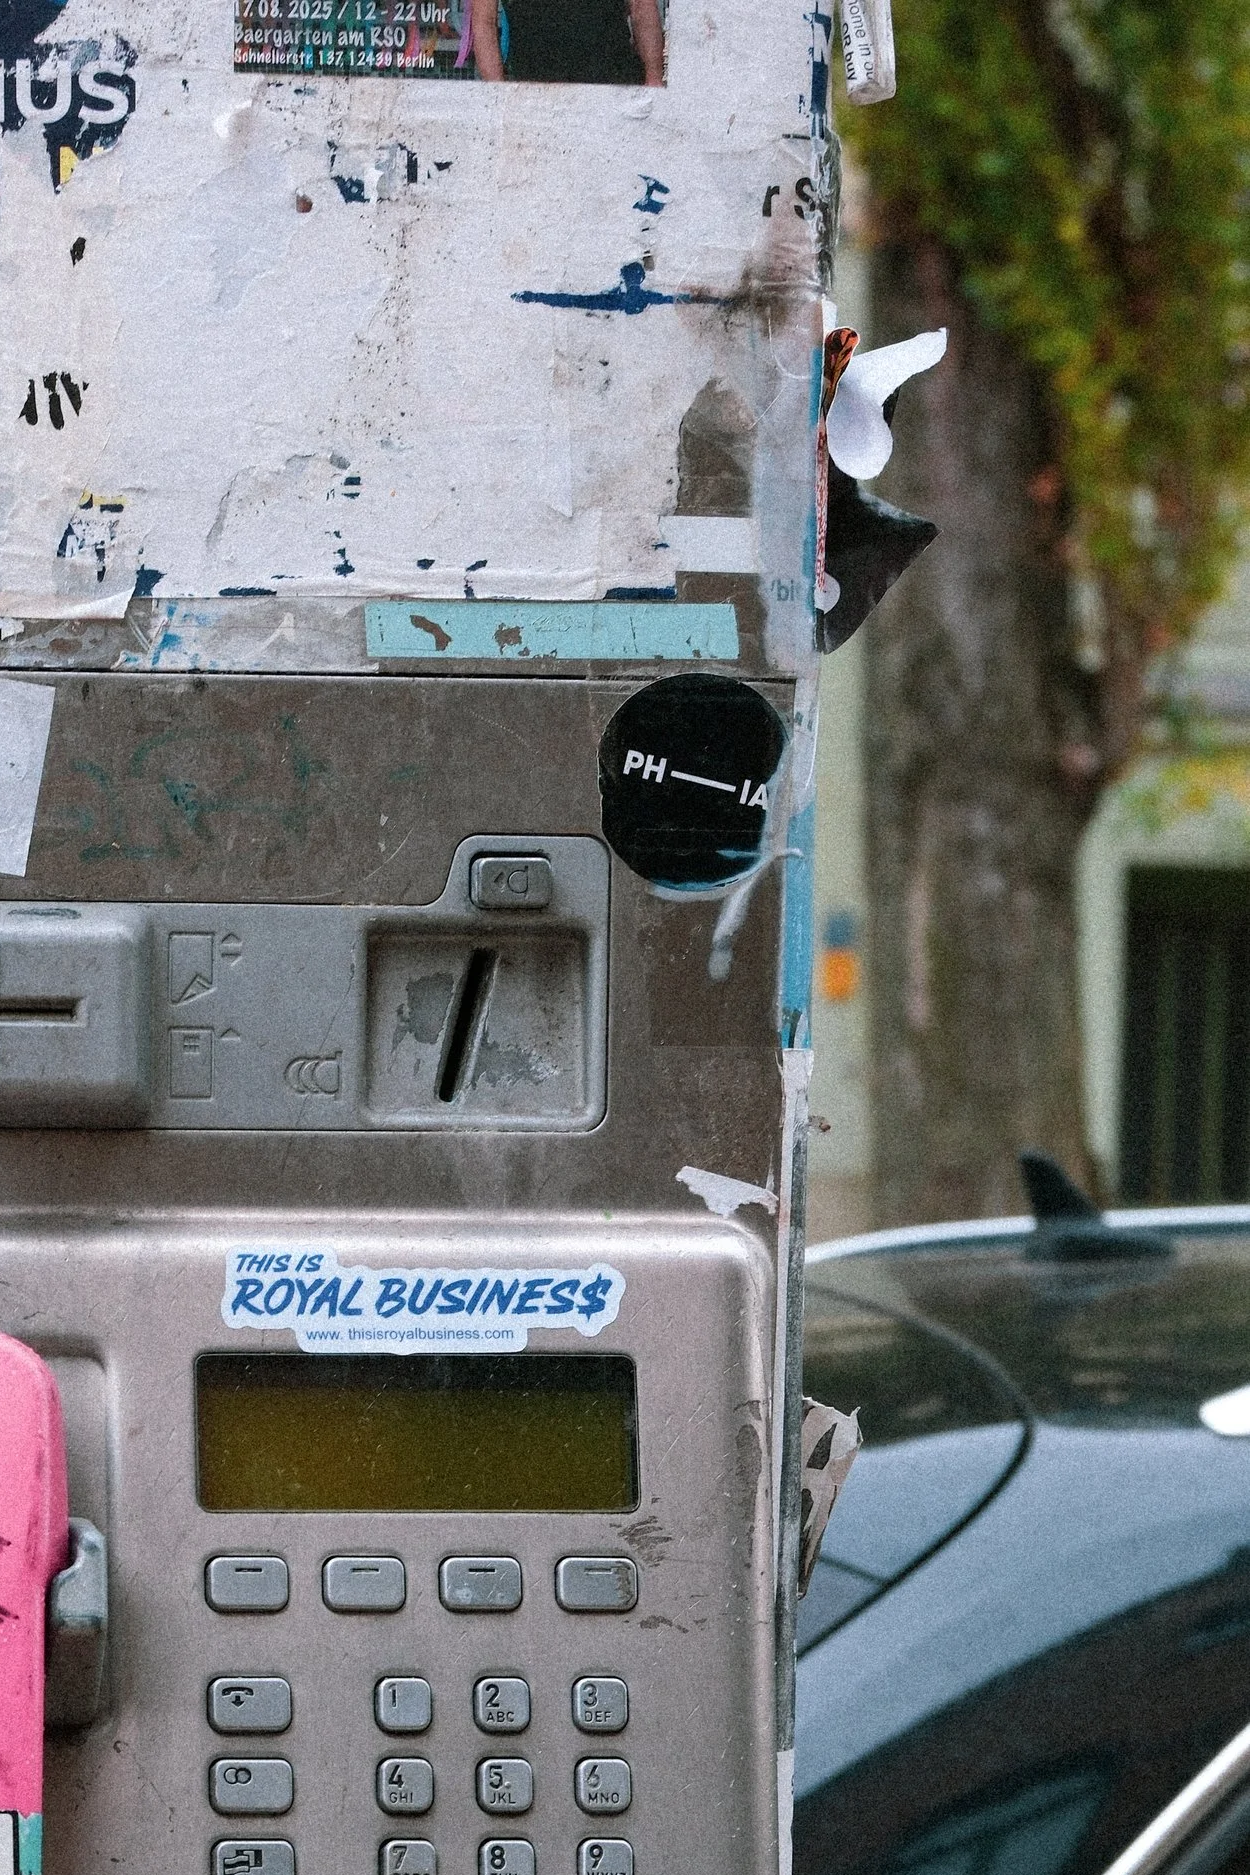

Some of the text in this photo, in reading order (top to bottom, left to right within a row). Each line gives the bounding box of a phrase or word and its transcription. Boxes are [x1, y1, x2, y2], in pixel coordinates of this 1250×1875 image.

[420, 4, 450, 23] Uhr
[234, 23, 406, 48] Baergarten am RSO
[349, 51, 393, 67] 12439
[397, 52, 435, 68] Berlin
[236, 1254, 324, 1273] THIS IS
[232, 1277, 366, 1319] ROYAL
[485, 1684, 500, 1708] 2
[582, 1683, 598, 1708] 3
[486, 1711, 515, 1722] ABC
[584, 1711, 612, 1722] DEF
[388, 1764, 404, 1789] 4
[585, 1765, 601, 1789] 6
[389, 1792, 413, 1804] GHI
[490, 1792, 516, 1804] JKL
[588, 1792, 620, 1804] MNO
[393, 1845, 408, 1870] 7
[490, 1845, 506, 1870] 8
[589, 1845, 604, 1870] 9
